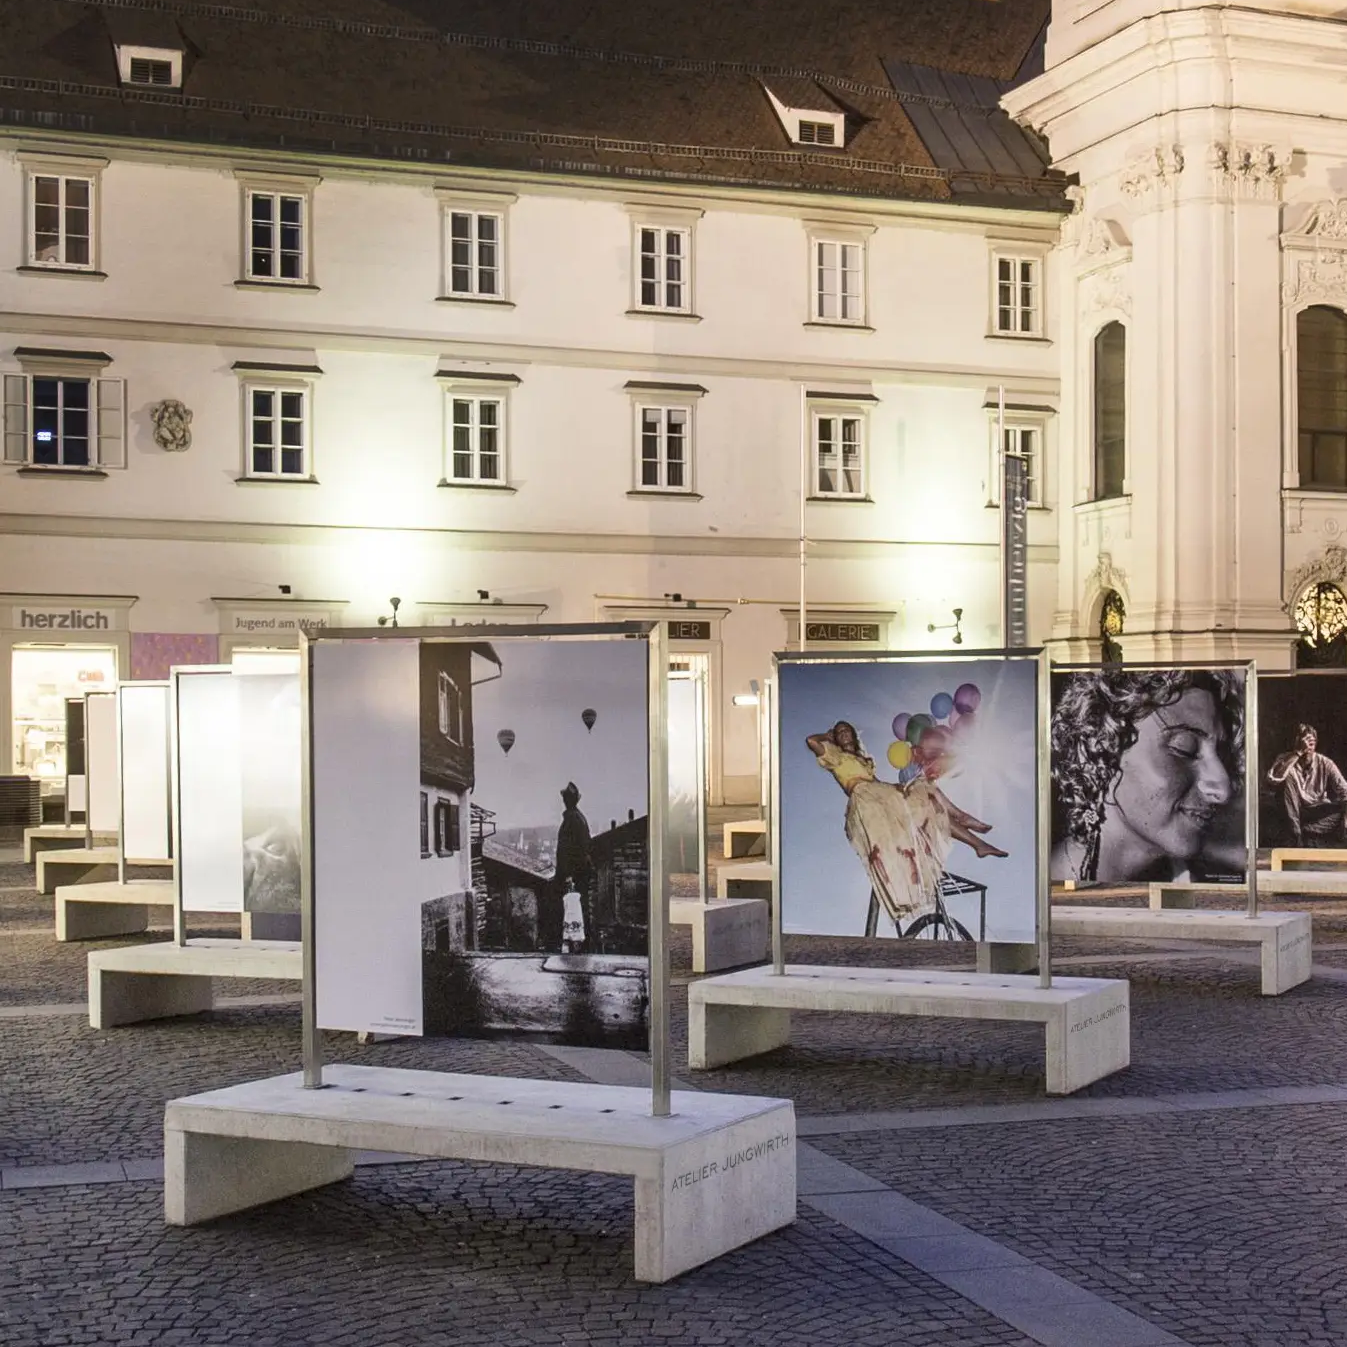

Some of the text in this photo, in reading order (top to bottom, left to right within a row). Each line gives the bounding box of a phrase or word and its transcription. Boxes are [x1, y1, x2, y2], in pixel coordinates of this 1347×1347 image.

[20, 609, 109, 629] herzlich
[235, 617, 328, 631] Jugend am Werk
[807, 624, 871, 640] GALERIE
[671, 1133, 789, 1192] ATELIER JUNGWIRTH
